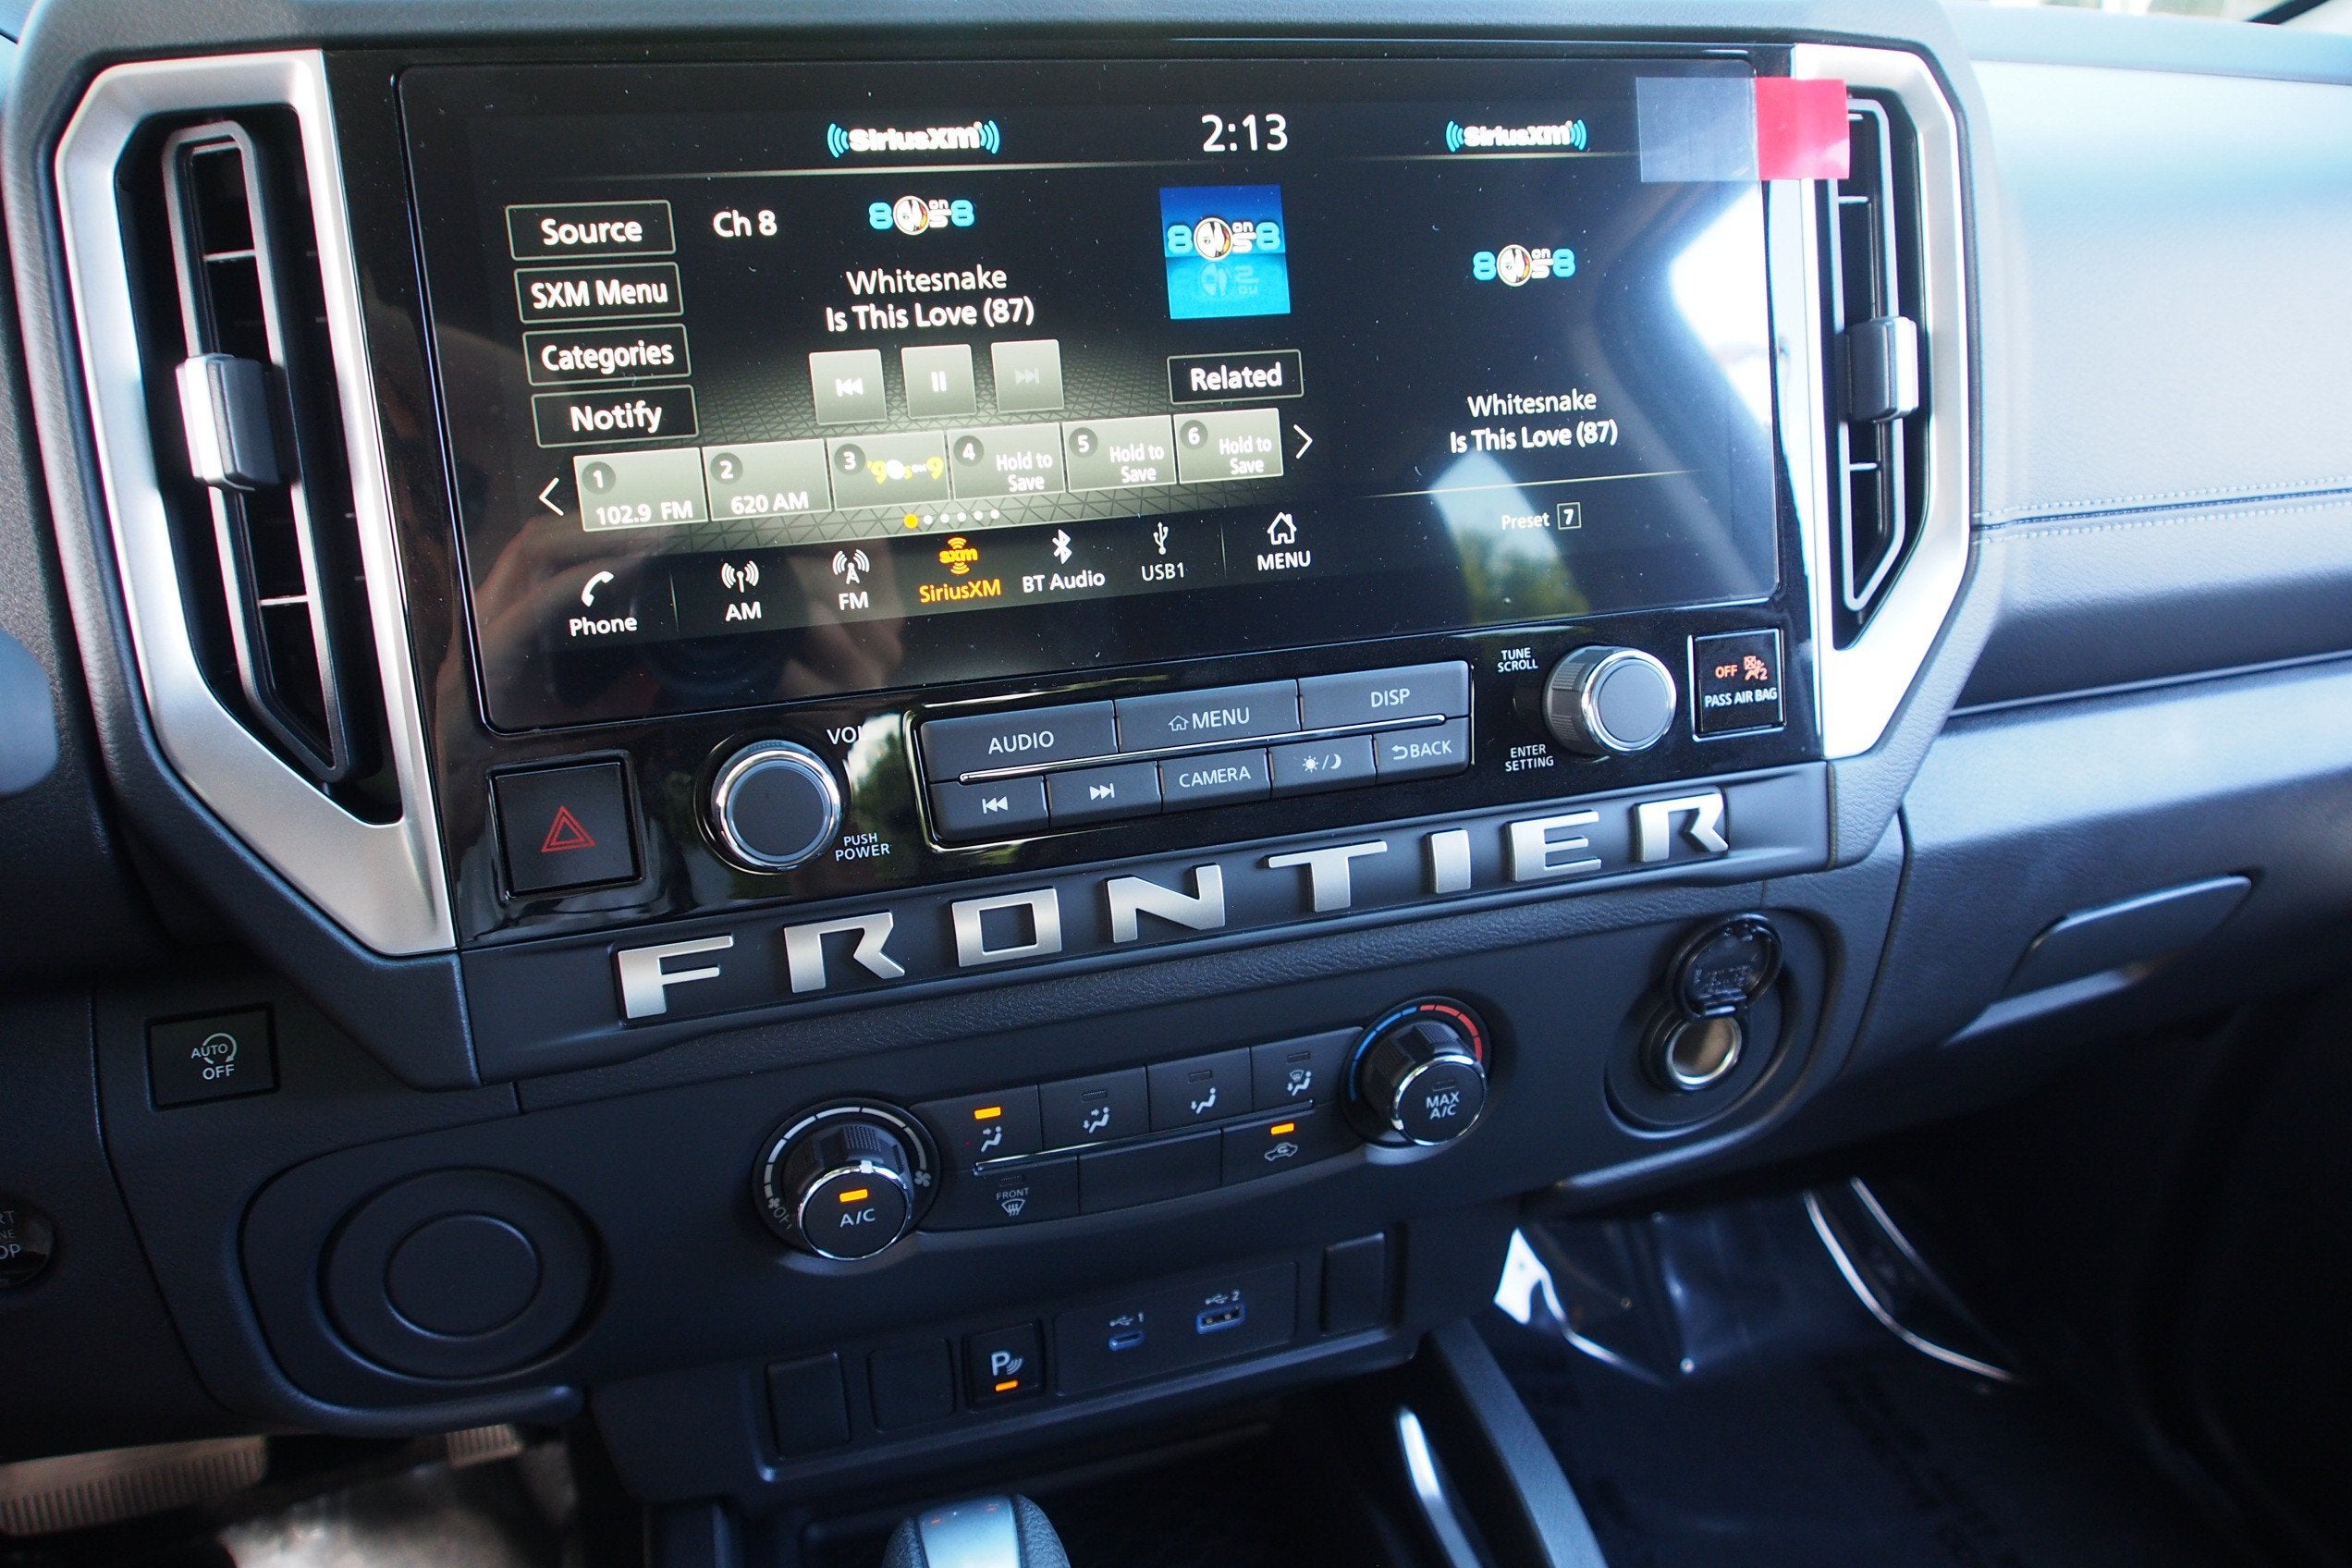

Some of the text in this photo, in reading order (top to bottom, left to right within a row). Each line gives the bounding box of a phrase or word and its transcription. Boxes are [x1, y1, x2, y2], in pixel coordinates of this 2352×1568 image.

[1202, 113, 1289, 153] 2:13
[541, 217, 643, 247] Source
[713, 209, 778, 239] Ch 8
[846, 264, 1008, 296] Whitesnake
[531, 278, 668, 311] SXM Menu
[826, 297, 1035, 333] Is This Love (87)
[541, 340, 674, 374] Categories
[1190, 361, 1283, 392] Related
[1466, 388, 1598, 418] Whitesnake
[570, 400, 662, 434] Notify
[1077, 434, 1090, 452] 5
[1187, 426, 1200, 444] 6
[1450, 419, 1619, 454] Is This Love (87)
[962, 442, 975, 460] 4
[1109, 444, 1165, 464] Hold to
[1219, 435, 1272, 456] Hold to
[719, 460, 734, 480] 2
[843, 451, 856, 471] 3
[996, 451, 1054, 472] Hold to
[1230, 458, 1265, 475] Save
[592, 470, 605, 488] 1
[1008, 473, 1046, 493] Save
[1121, 465, 1157, 484] Save
[595, 500, 693, 526] 102.9 FM
[730, 491, 809, 516] 620 AM
[1501, 508, 1574, 530] Preset 7
[1257, 550, 1311, 571] MENU
[1022, 570, 1106, 594] BT Audio
[1141, 562, 1185, 582] USB1
[839, 591, 870, 611] FM
[919, 578, 1001, 604] SiriusXM
[725, 601, 762, 621] AM
[570, 614, 638, 637] Phone
[1501, 646, 1532, 661] TUNE
[1497, 657, 1539, 673] SCROLL
[1715, 664, 1738, 679] OFF
[1370, 688, 1411, 708] DISP
[1704, 687, 1778, 708] PASS AIR BAG
[1192, 706, 1250, 729] MENU
[988, 730, 1055, 755] AUDIO
[1409, 740, 1452, 758] BACK
[1510, 743, 1547, 759] ENTER
[1505, 755, 1555, 772] SETTING
[1179, 766, 1252, 789] CAMERA
[843, 831, 878, 848] PUSH
[835, 842, 891, 862] POWER
[618, 792, 1729, 1019] FRONTIER
[190, 1042, 229, 1060] AUTO
[202, 1063, 236, 1081] OFF
[1426, 1090, 1460, 1109] MAX
[1429, 1103, 1457, 1121] A/C
[996, 1187, 1030, 1201] FRONT
[839, 1207, 876, 1228] A/C
